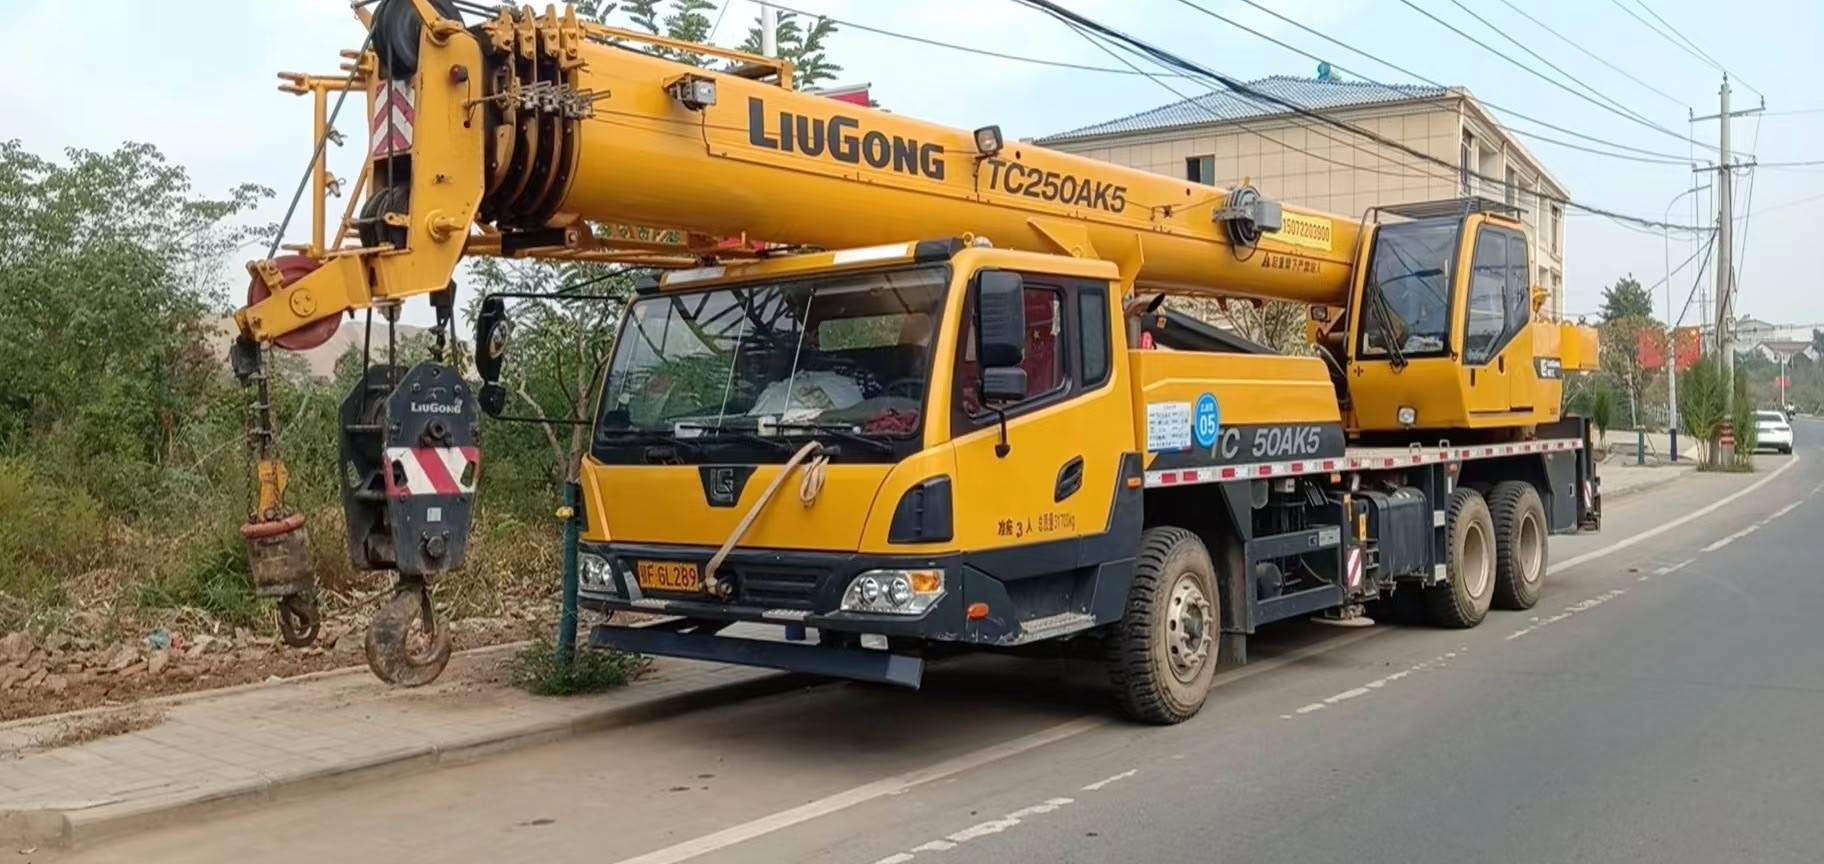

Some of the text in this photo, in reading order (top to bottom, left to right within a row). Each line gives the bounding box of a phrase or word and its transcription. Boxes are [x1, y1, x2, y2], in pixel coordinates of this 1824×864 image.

[987, 157, 1127, 214] TC250AK5
[1200, 413, 1216, 436] 05
[1252, 426, 1321, 457] 50AK5
